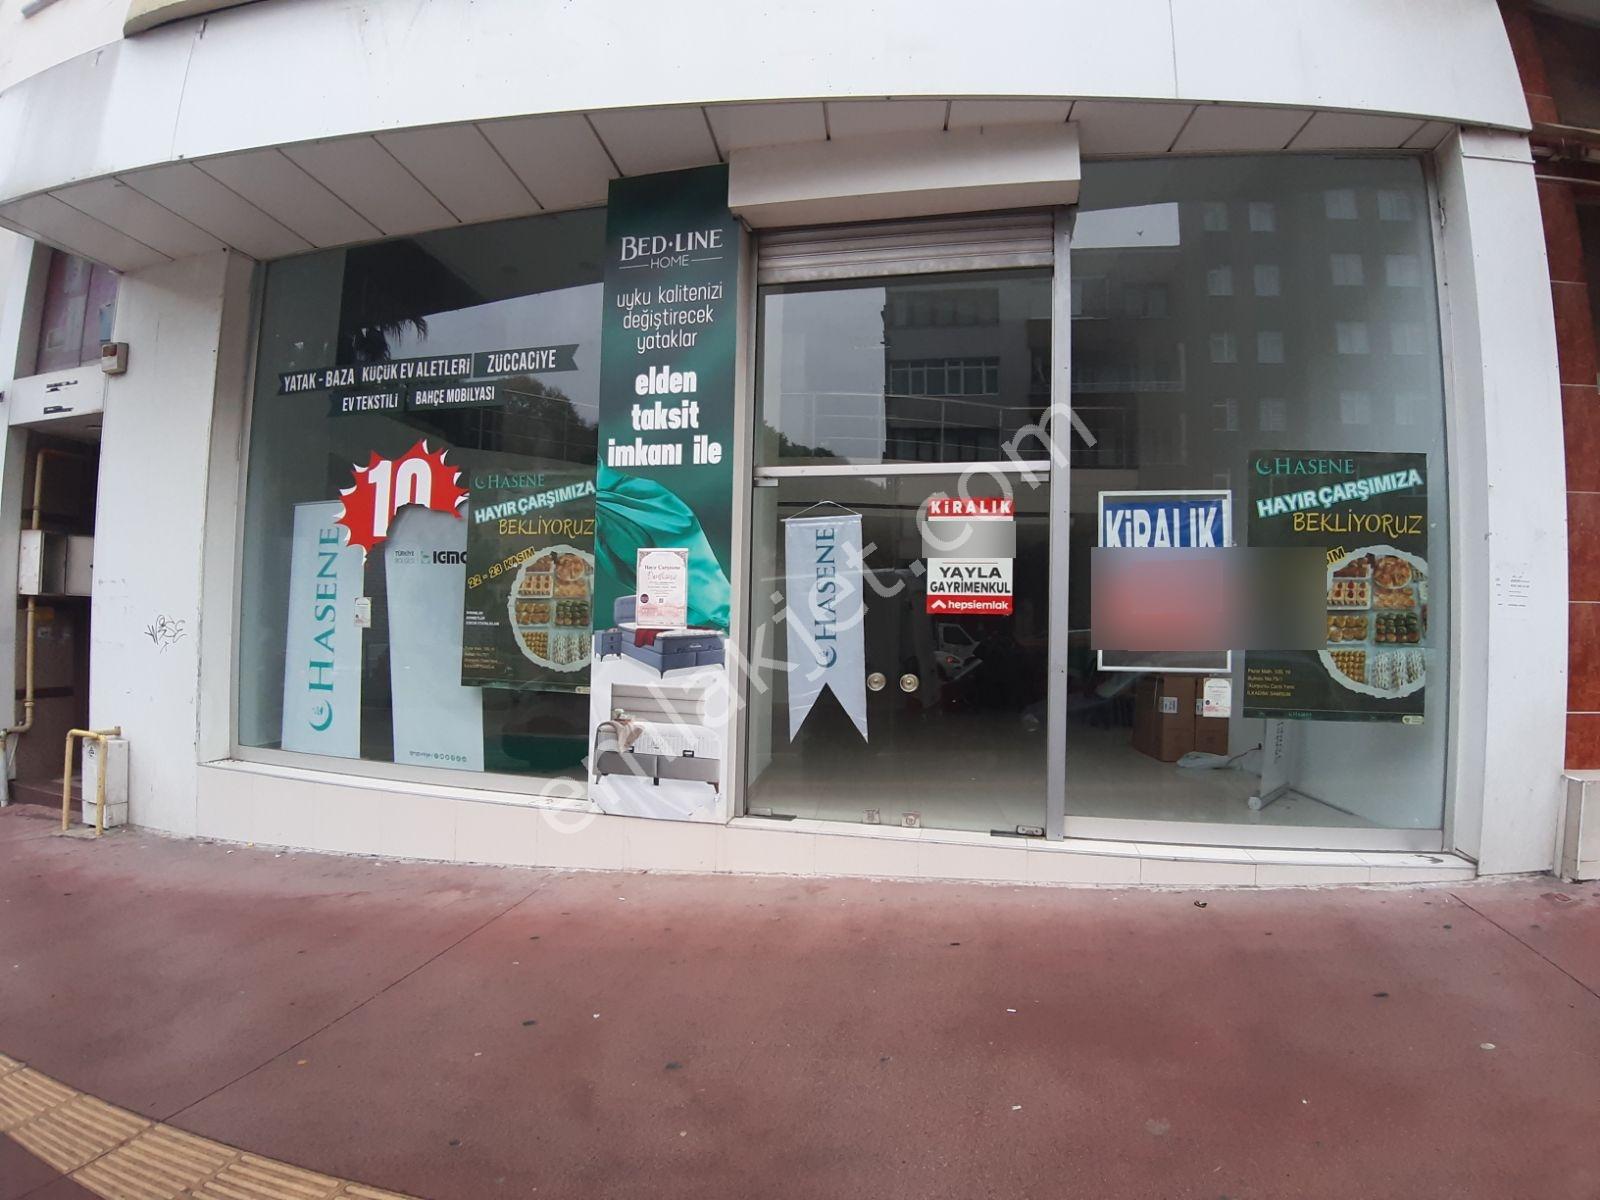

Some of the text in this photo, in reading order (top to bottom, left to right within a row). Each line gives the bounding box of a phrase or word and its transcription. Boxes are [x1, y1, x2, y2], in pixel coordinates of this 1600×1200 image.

[650, 254, 690, 269] HOME
[616, 281, 723, 312] uyku kalitenizi
[623, 304, 714, 332] değiştirecek
[637, 331, 698, 354] yataklar
[284, 373, 317, 392] YATAK
[325, 368, 355, 388] BAZA
[362, 363, 399, 384] KÜÇÜK
[399, 362, 416, 379] EV
[635, 365, 697, 395] elden
[342, 397, 355, 411] EV
[415, 389, 445, 406] BAHÇE
[631, 400, 699, 431] taksit
[607, 434, 722, 467] imkanı ile
[488, 474, 544, 489] HASENE
[1275, 459, 1354, 476] HASENE
[367, 457, 432, 537] 10
[474, 480, 596, 524] HAYIR ÇARŞIMIZA
[1256, 469, 1423, 518] HAYIR ÇARŞIMIZA
[499, 515, 595, 538] BEKLİYORUZ
[1293, 509, 1423, 538] BEKLİYORUZ
[468, 575, 482, 588] 22
[488, 563, 502, 579] 23
[503, 546, 536, 571] KASIM
[939, 567, 1002, 578] YAYLA
[815, 527, 837, 641] HASENE
[930, 578, 1011, 593] GAYRİMENKUL
[308, 527, 340, 692] HASENE
[948, 600, 1008, 614] hepsiemlak
